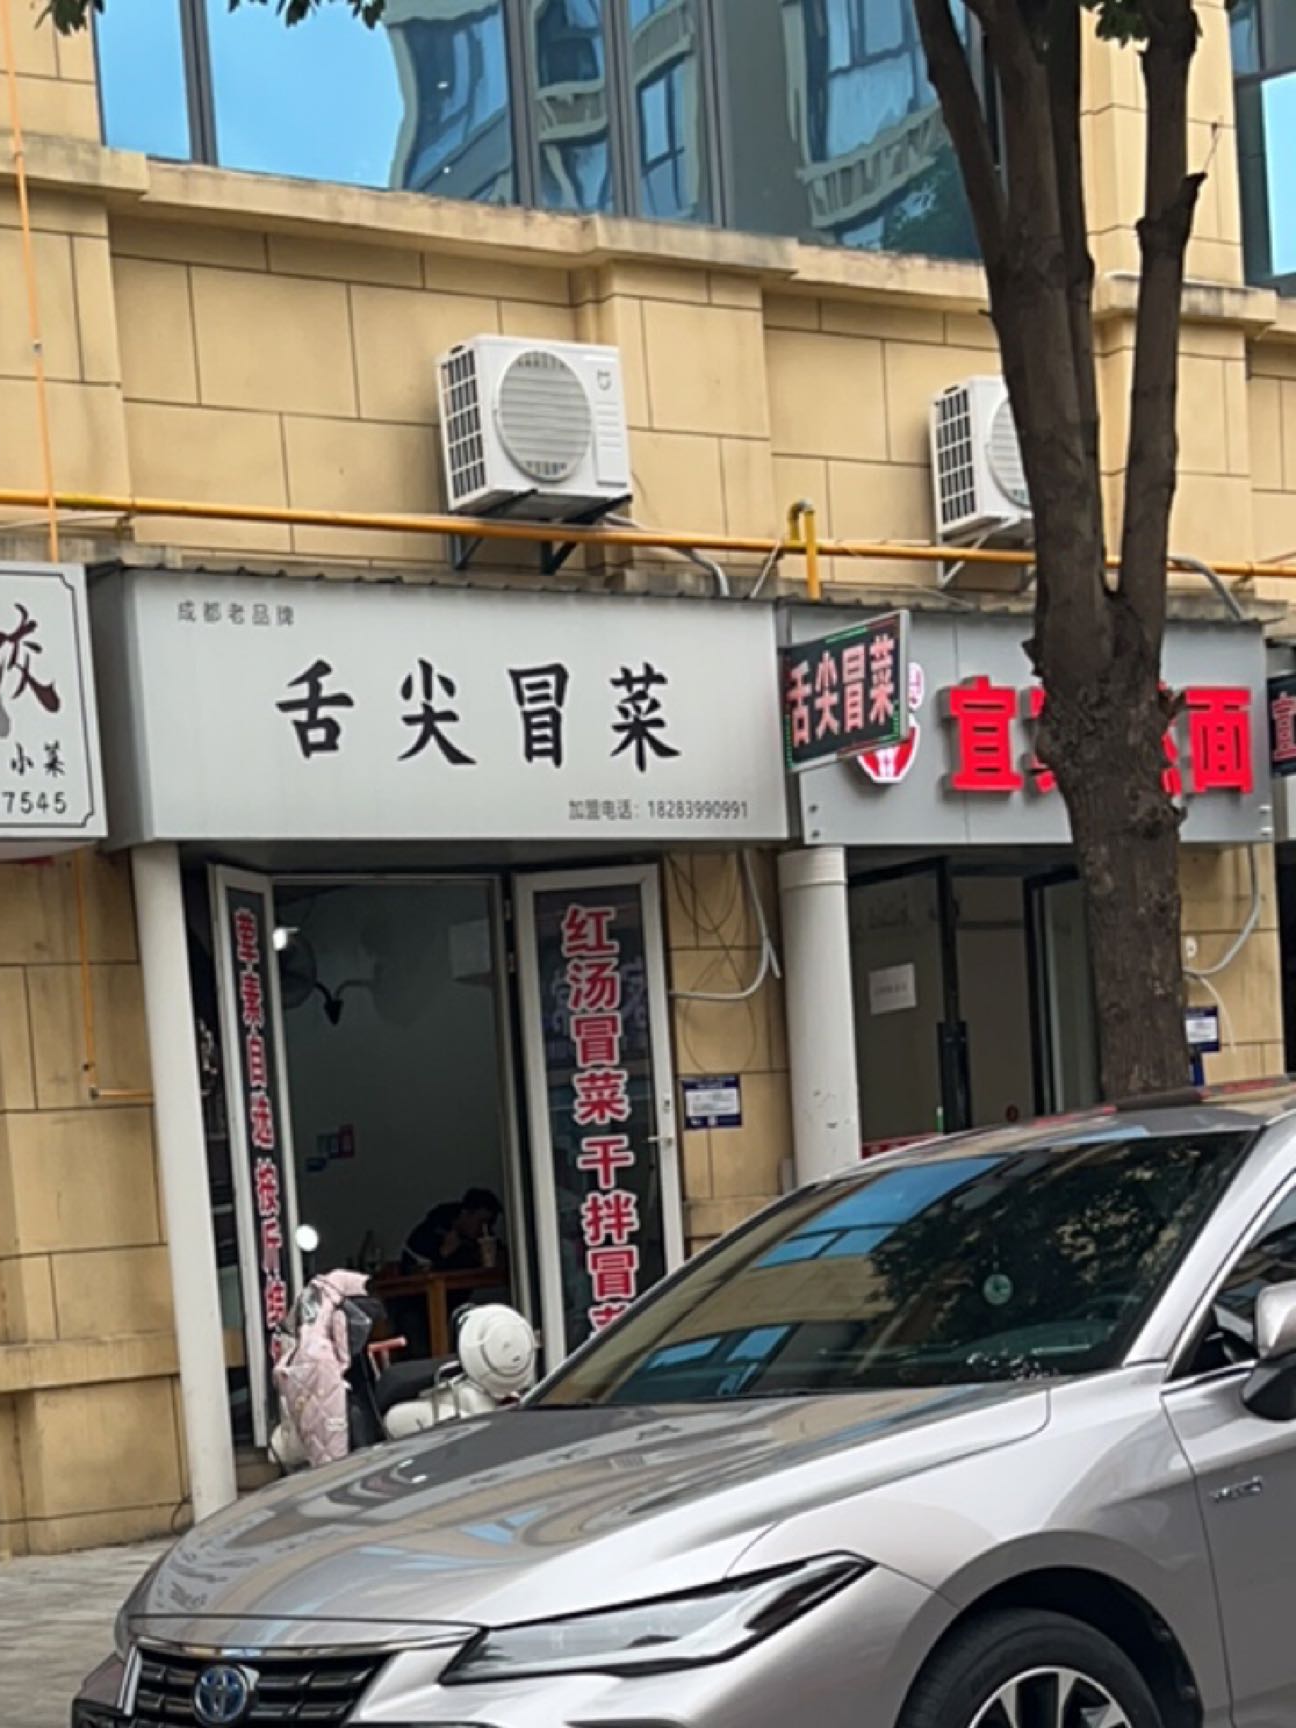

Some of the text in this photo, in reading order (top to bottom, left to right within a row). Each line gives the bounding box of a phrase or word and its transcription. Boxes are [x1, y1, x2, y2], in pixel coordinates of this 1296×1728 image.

[177, 600, 295, 626] 成都老品牌
[276, 658, 681, 772] 舌尖冒菜
[787, 633, 895, 748] 舌尖冒菜
[948, 675, 1254, 794] 宜面
[10, 741, 67, 776] 小菜
[562, 905, 628, 1125] 红汤冒菜
